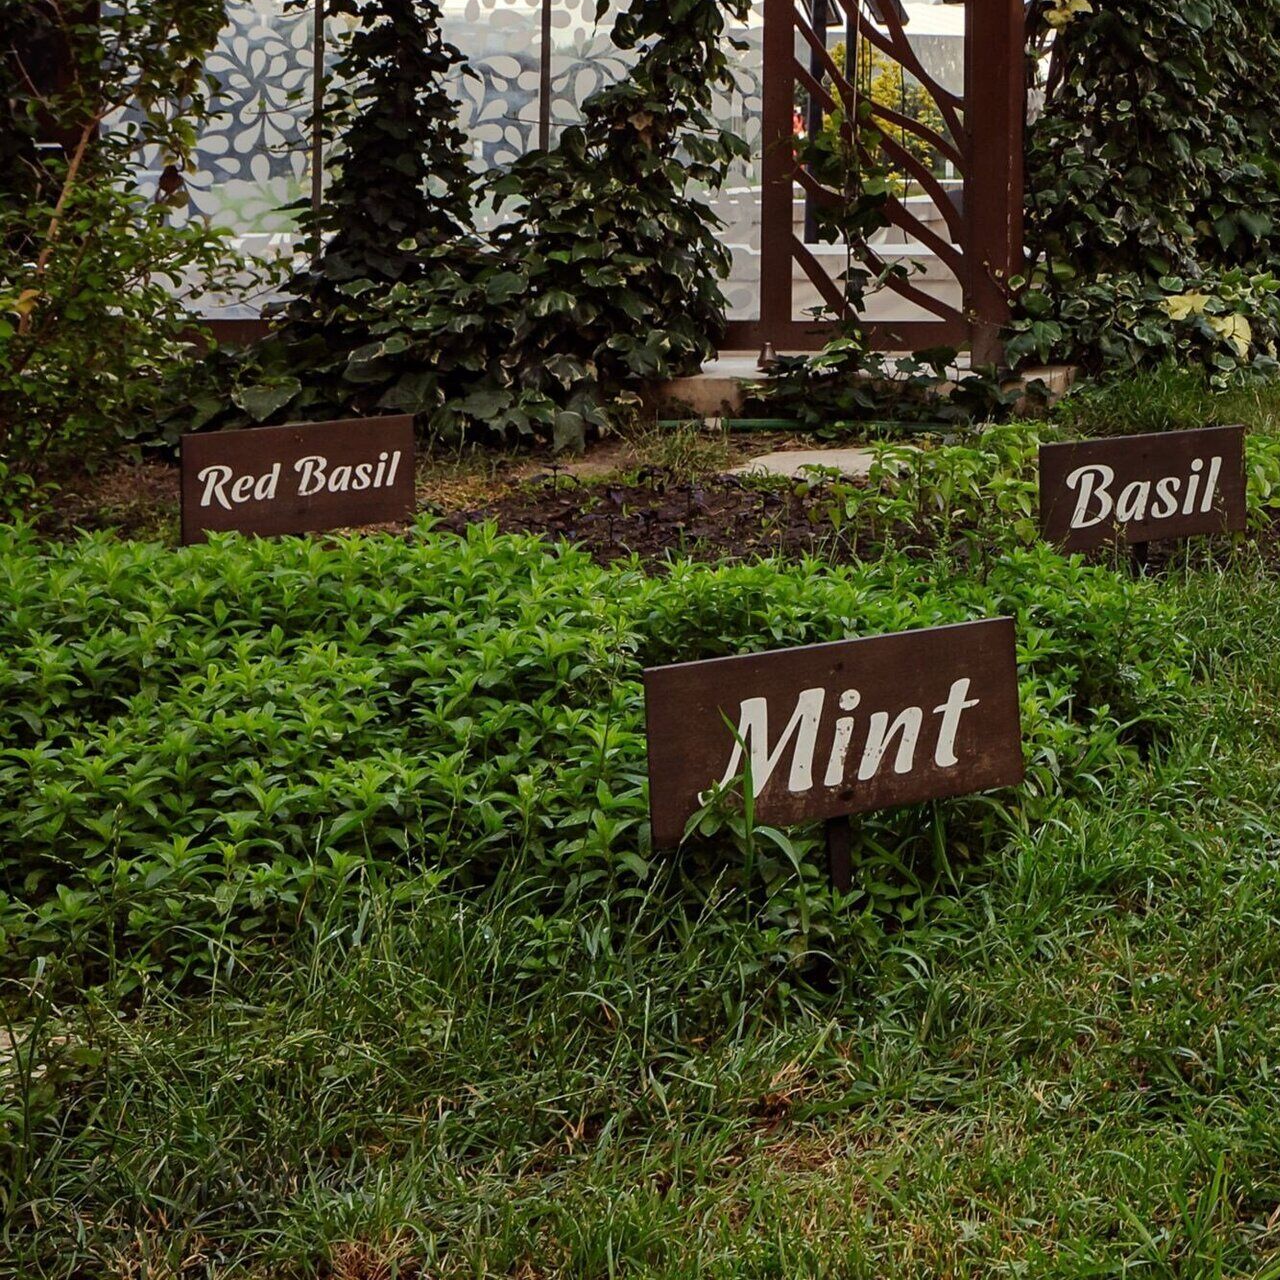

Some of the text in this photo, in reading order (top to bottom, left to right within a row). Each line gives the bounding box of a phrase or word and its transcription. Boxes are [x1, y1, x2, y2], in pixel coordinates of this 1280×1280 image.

[198, 451, 401, 510] Red Basil
[1066, 456, 1222, 529] Basil
[697, 677, 980, 807] Mint
